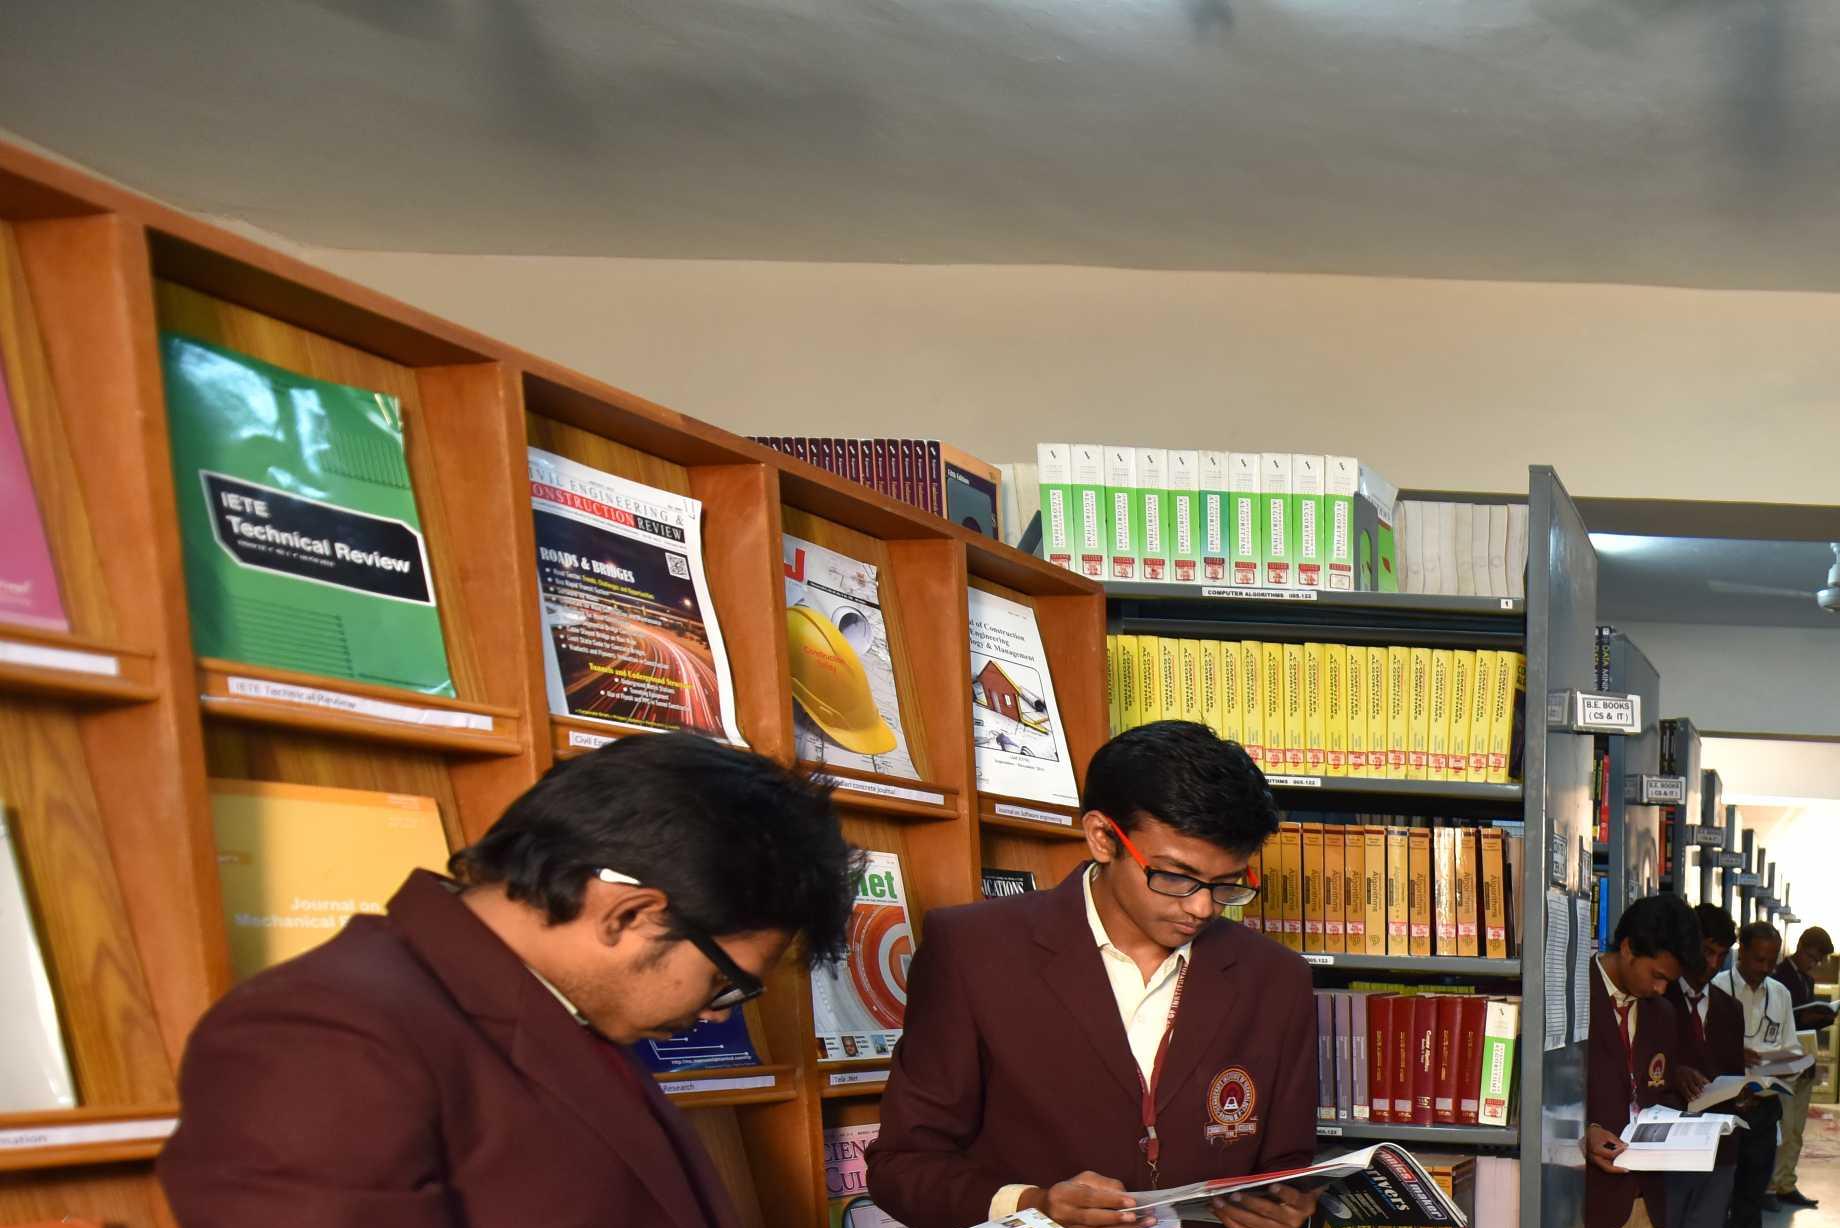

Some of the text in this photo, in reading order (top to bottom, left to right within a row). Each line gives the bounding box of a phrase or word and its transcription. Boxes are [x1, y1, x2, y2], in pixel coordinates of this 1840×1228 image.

[221, 491, 270, 517] IETE
[528, 466, 563, 487] IVIL
[570, 479, 670, 521] ENGINEERING
[675, 516, 684, 526] &
[532, 484, 635, 527] ONSTRUCTION
[637, 517, 682, 541] REVIEW
[225, 516, 330, 556] Technical
[334, 542, 411, 573] Review
[540, 547, 635, 583] ROADS & BRIDGES
[1208, 589, 1243, 597] COMPUTER
[984, 623, 1026, 641] Construction
[993, 644, 1035, 662] Management
[1586, 701, 1630, 710] B.E. BOOKS
[1606, 712, 1612, 720] &
[574, 736, 591, 745] Civil
